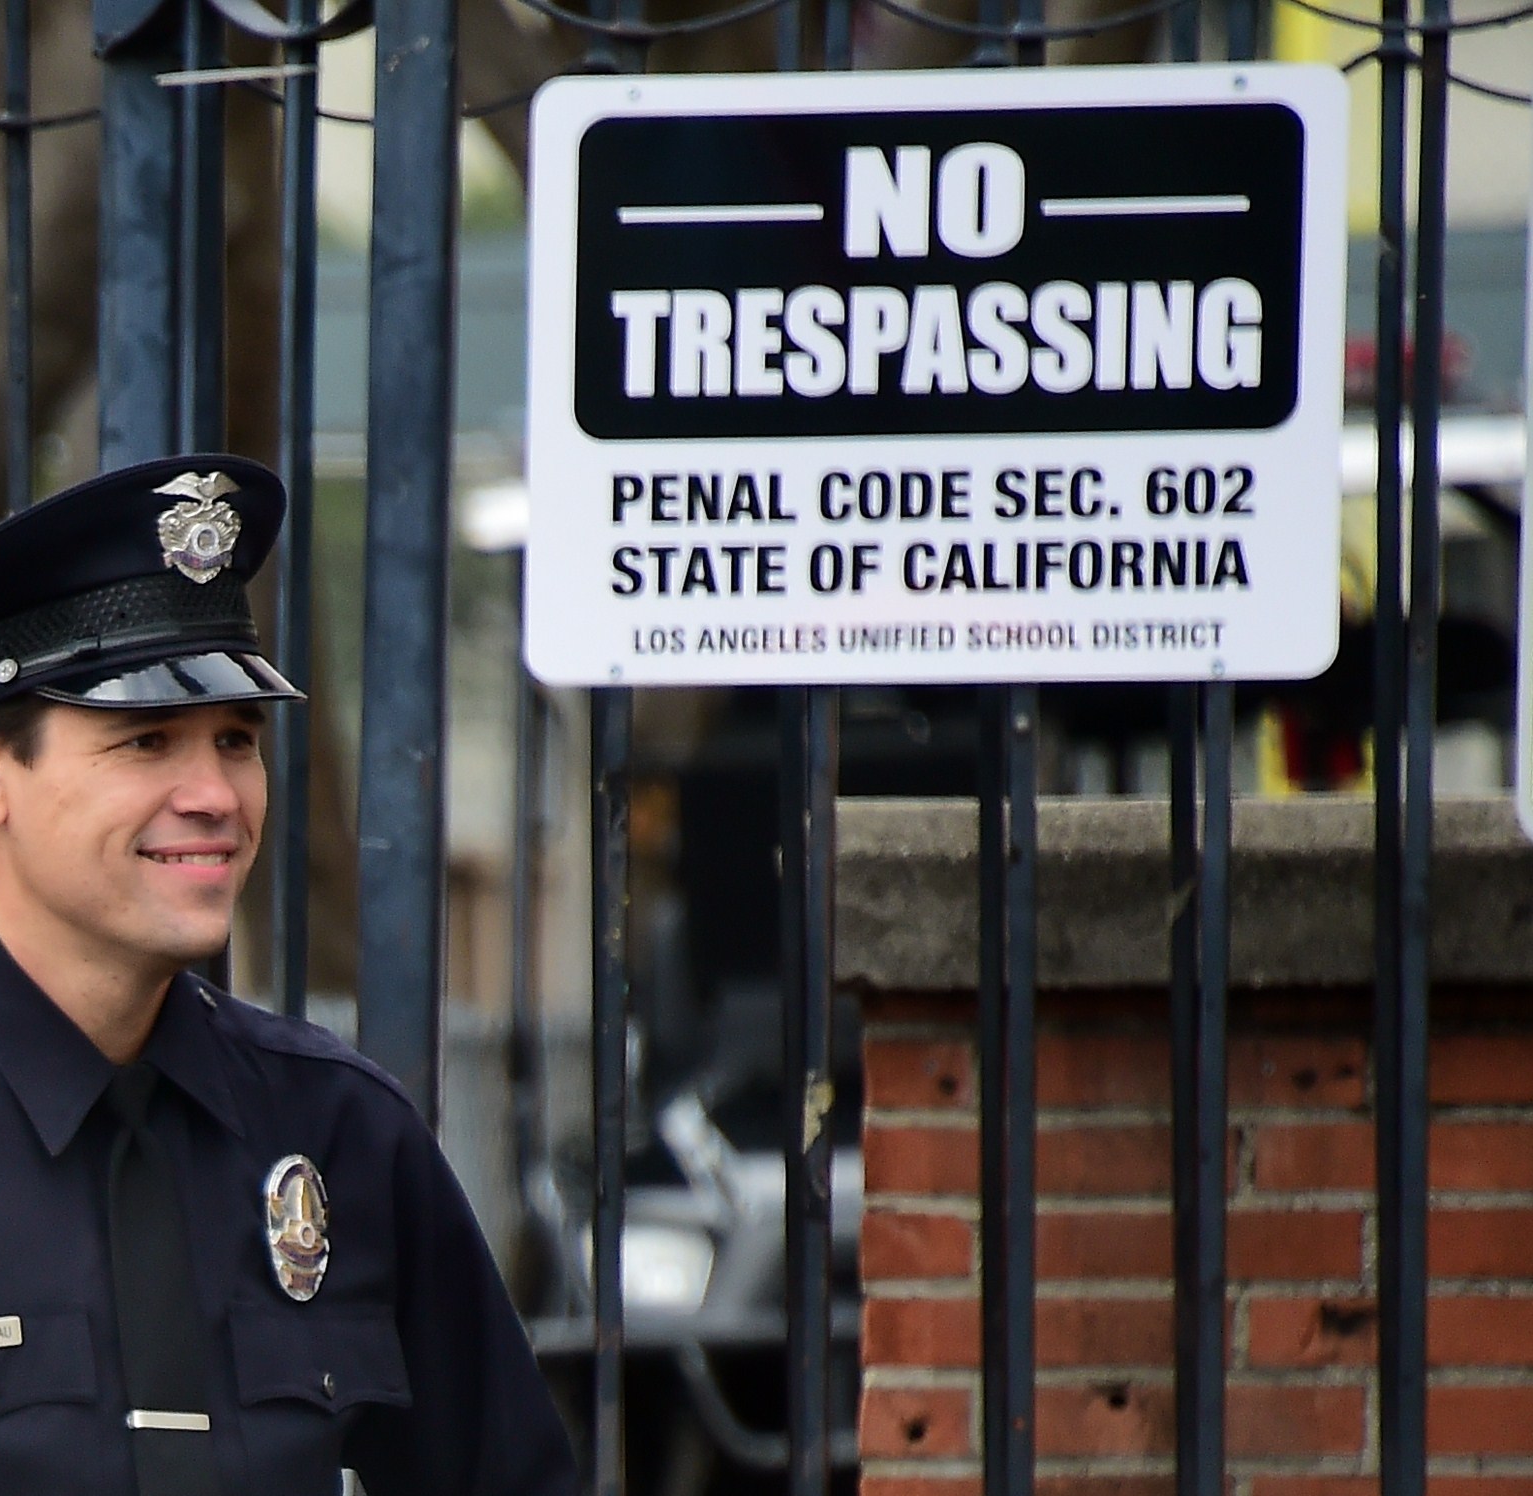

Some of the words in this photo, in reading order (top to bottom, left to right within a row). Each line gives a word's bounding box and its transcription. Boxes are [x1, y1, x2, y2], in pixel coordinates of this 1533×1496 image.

[844, 142, 1026, 258] NO
[611, 277, 1263, 398] TRESPASSING
[612, 473, 797, 523] PENAL
[819, 470, 971, 522] CODE
[994, 466, 1121, 519] SEC.
[1145, 465, 1254, 517] 602
[611, 545, 787, 597] STATE
[809, 543, 880, 594] OF
[903, 538, 1251, 592] CALIFORNIA
[634, 628, 686, 654] LOS
[697, 626, 827, 654] ANGELES
[838, 624, 956, 652] UNIFIED
[967, 623, 1079, 650] SCHOOL
[1092, 620, 1225, 649] DISTRICT
